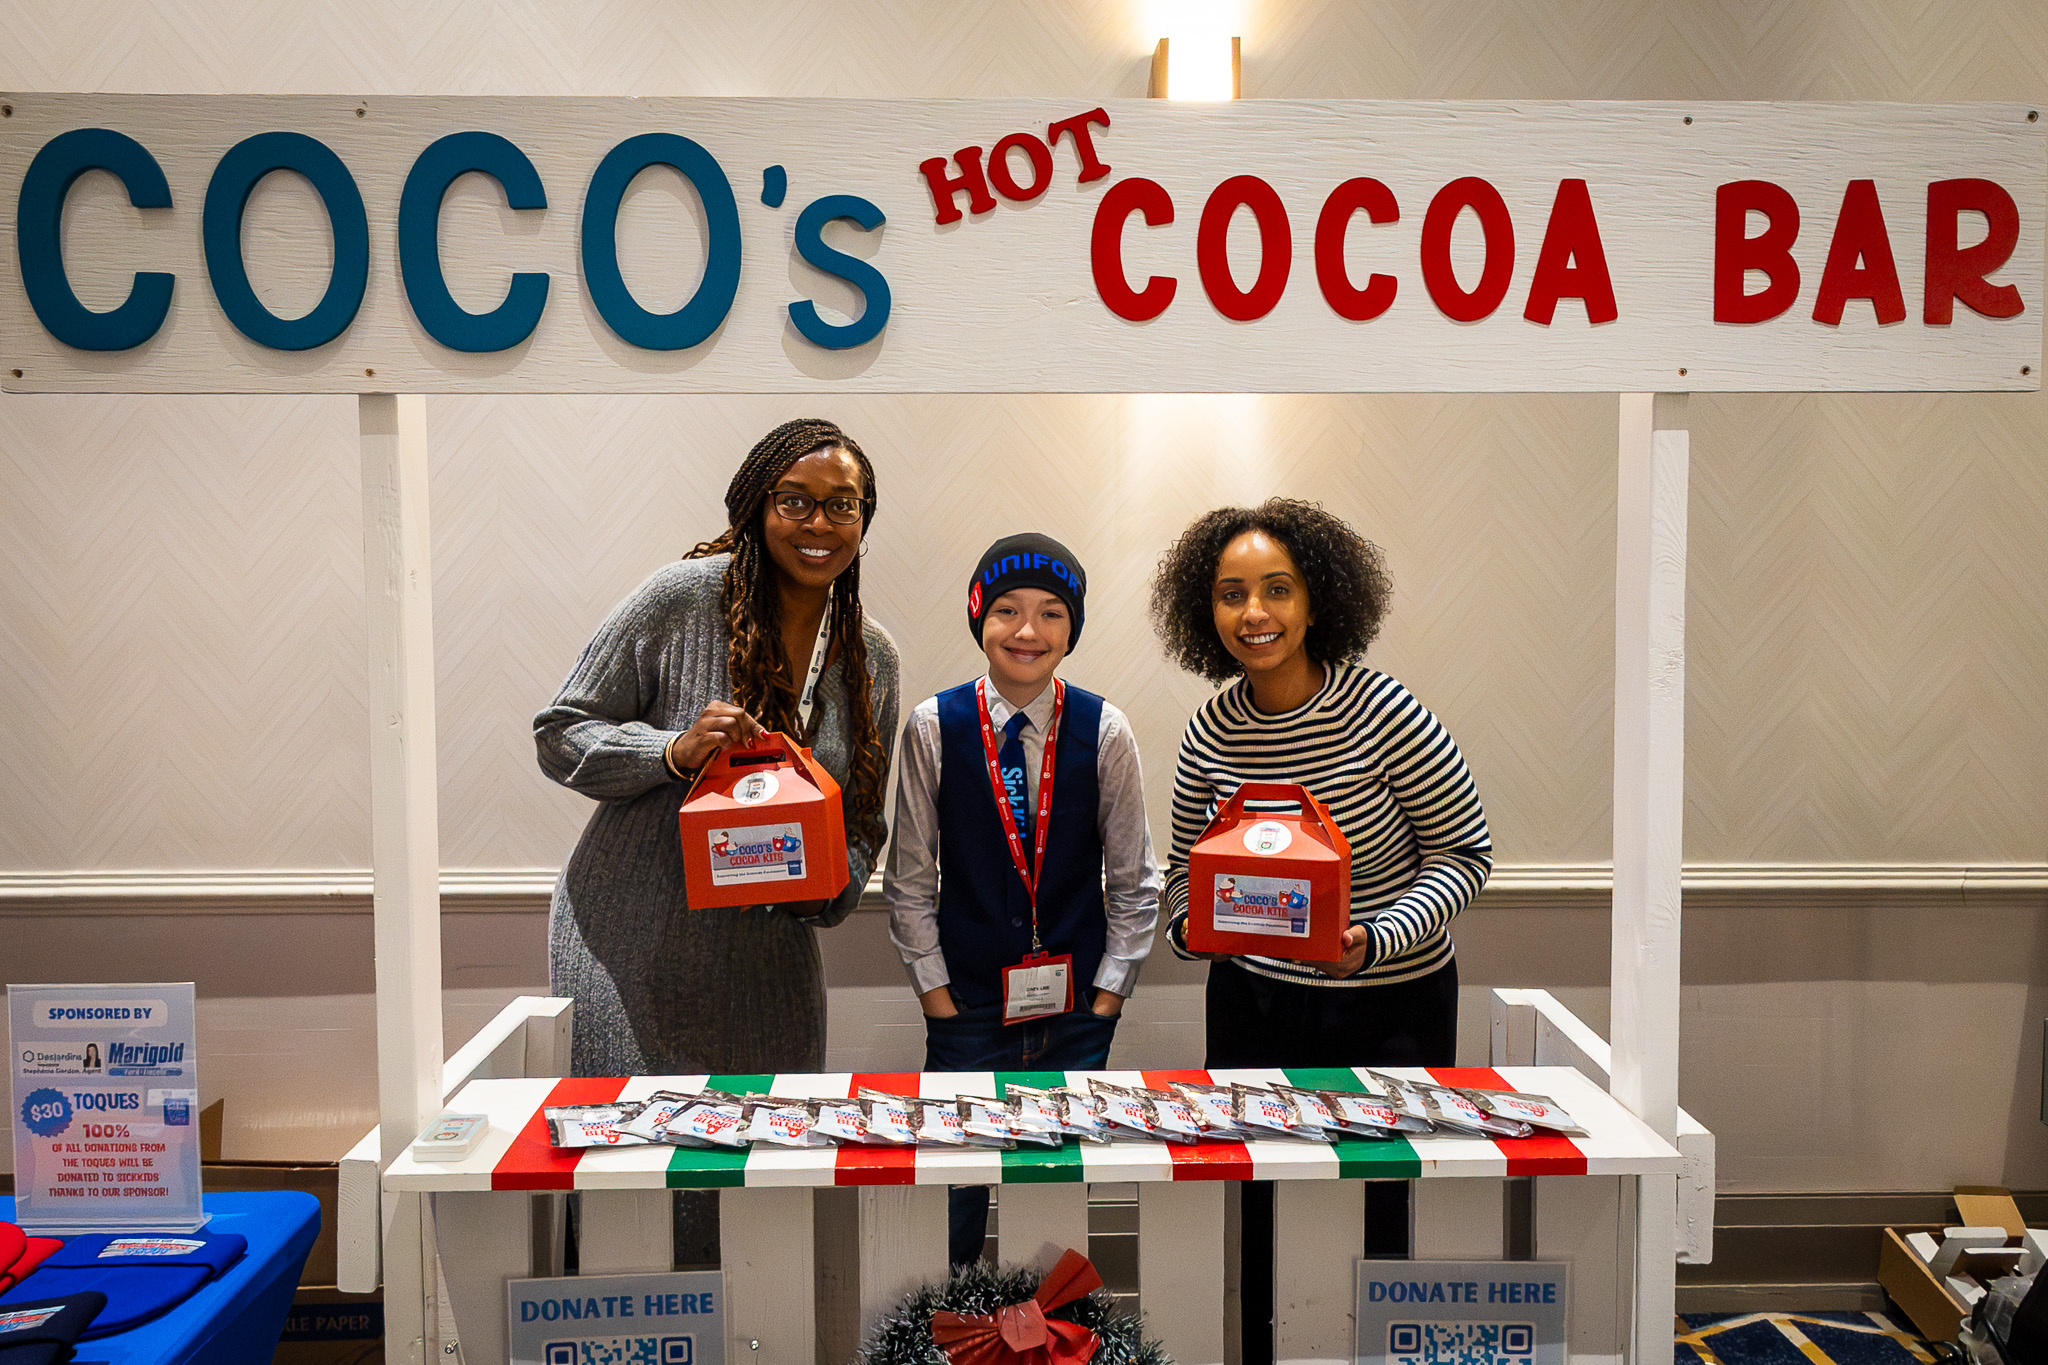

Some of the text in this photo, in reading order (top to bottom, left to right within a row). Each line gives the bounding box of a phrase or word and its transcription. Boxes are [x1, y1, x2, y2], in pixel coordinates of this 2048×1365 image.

[17, 106, 2025, 352] COCO's HOT COCOA BAR
[984, 552, 1080, 596] UNIFOR
[738, 843, 773, 856] COCO'S
[729, 852, 784, 866] COCOA KITS
[1243, 894, 1279, 907] COCO'S
[1232, 903, 1289, 918] COCOA KITS
[48, 1007, 153, 1021] SPONSORED BY
[37, 1052, 83, 1063] Desjardins
[108, 1042, 185, 1066] Marigold
[73, 1092, 140, 1113] TOQUES
[30, 1101, 64, 1123] $30
[82, 1123, 130, 1139] 100%
[52, 1143, 166, 1153] OF ALL DONATIONS FROM
[62, 1157, 154, 1168] THE TOQUES WILL BE
[57, 1172, 160, 1183] DONATED TO SICKKIDS
[49, 1187, 169, 1198] THANKS TO OUR SPONSOR!
[1368, 1281, 1557, 1304] DONATE HERE
[520, 1292, 715, 1323] DONATE HERE
[315, 1314, 370, 1333] PAPER
